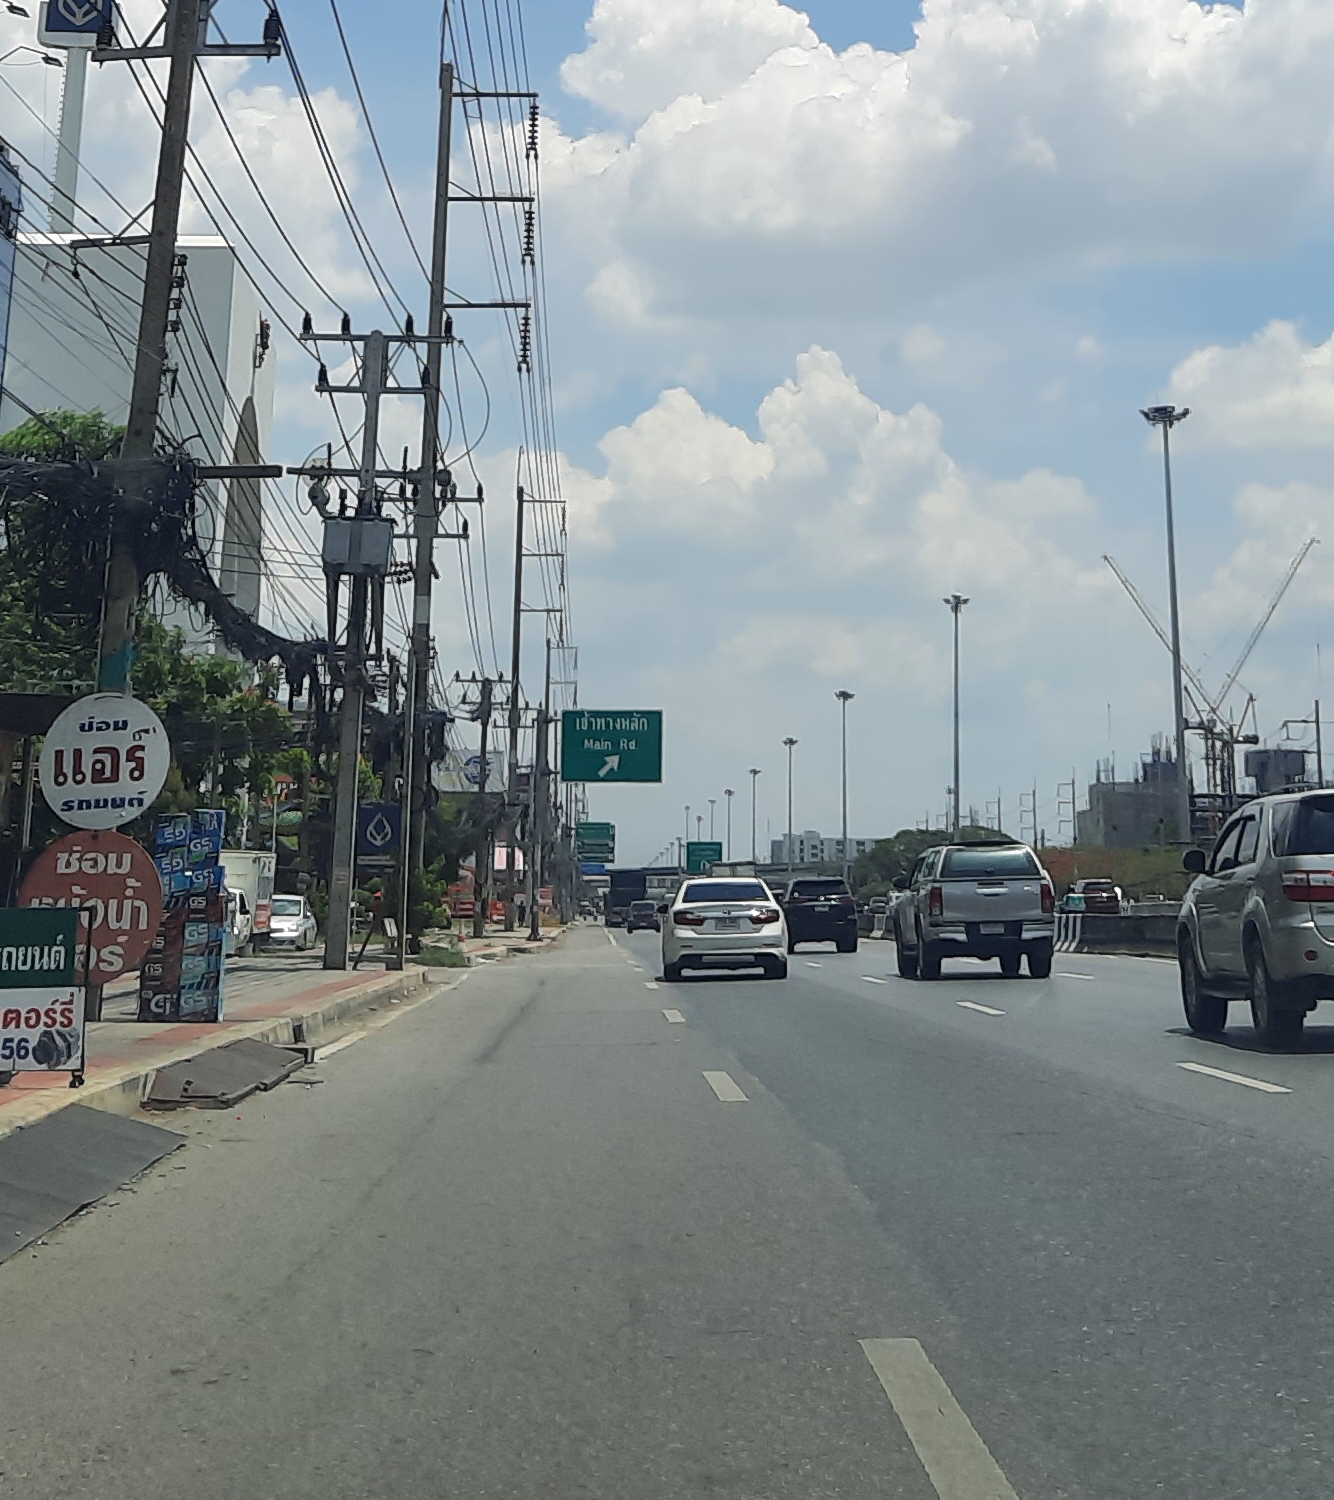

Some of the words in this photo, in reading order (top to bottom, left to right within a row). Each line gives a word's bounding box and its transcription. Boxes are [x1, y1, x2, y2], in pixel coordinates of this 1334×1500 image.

[576, 712, 648, 731] เข้าทางหลัก
[584, 738, 612, 751] Main
[619, 738, 638, 751] Rd.
[54, 727, 157, 787] แอร์
[60, 790, 148, 812] รถยนต์
[190, 837, 213, 852] GS
[56, 846, 132, 874] ซ่อม
[186, 923, 208, 940] GS
[74, 935, 126, 972] อร์
